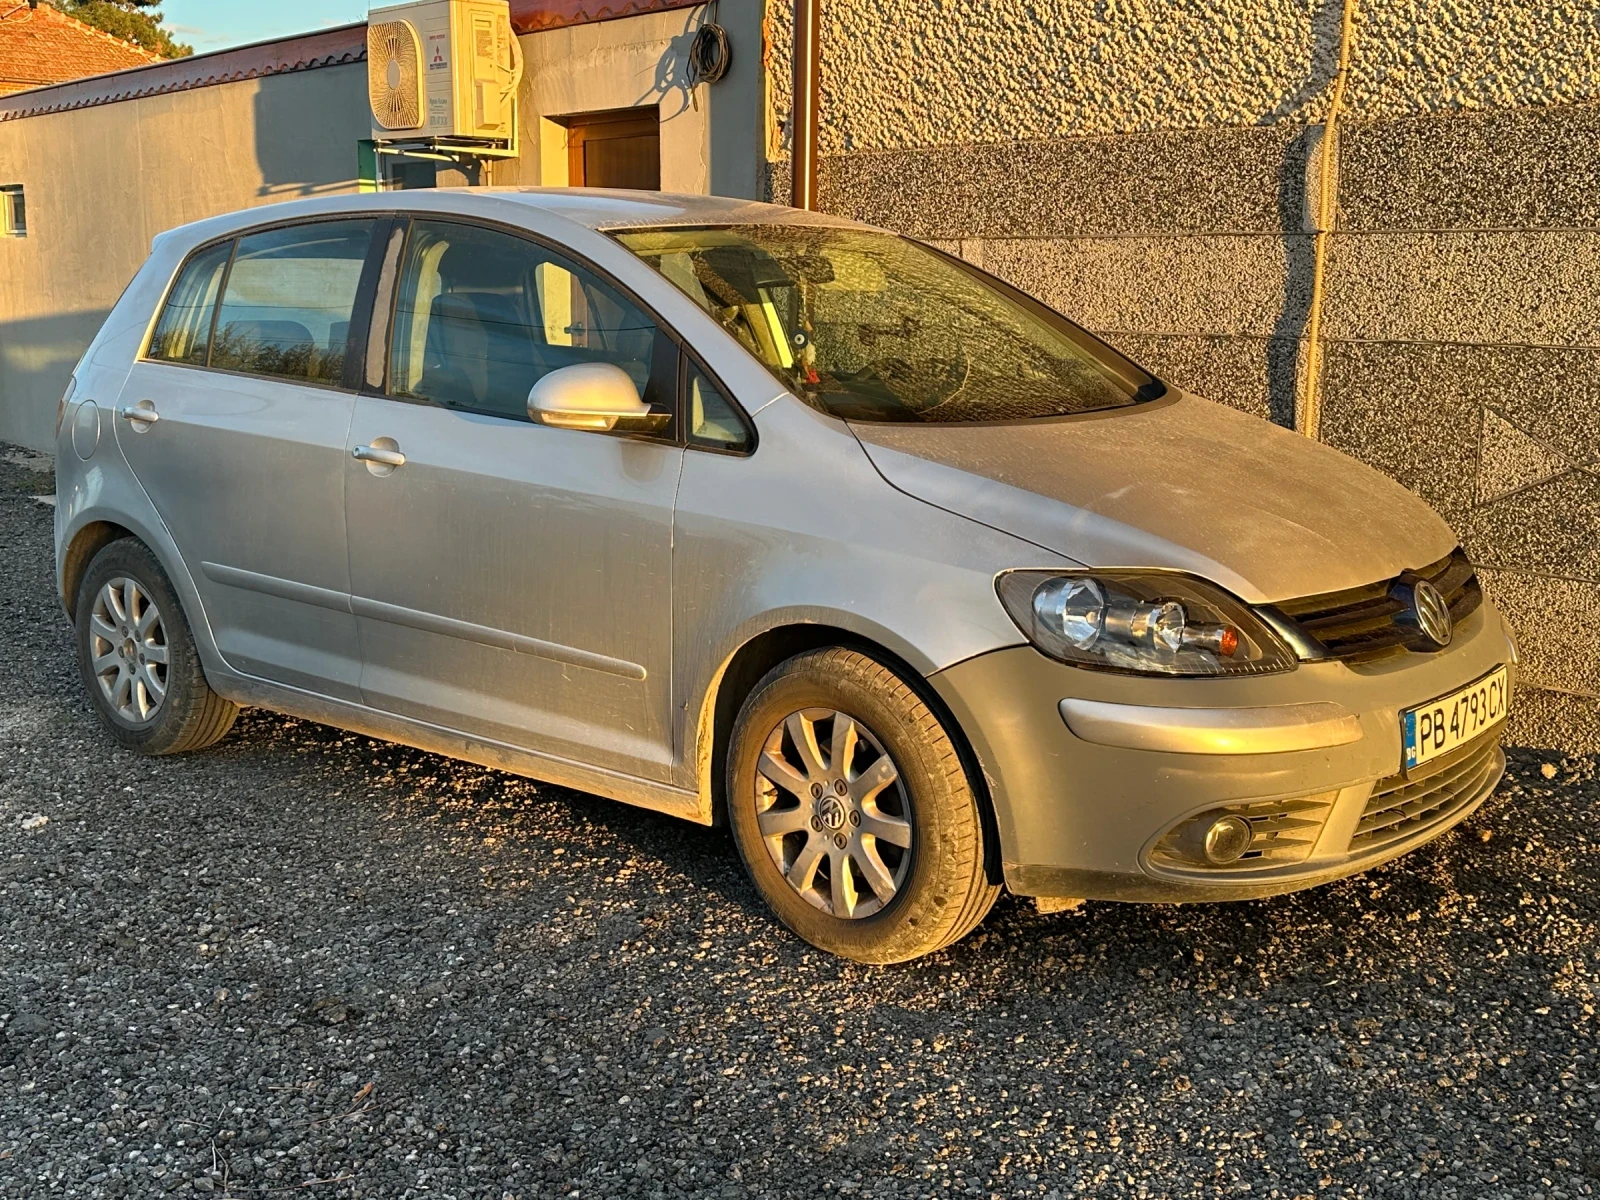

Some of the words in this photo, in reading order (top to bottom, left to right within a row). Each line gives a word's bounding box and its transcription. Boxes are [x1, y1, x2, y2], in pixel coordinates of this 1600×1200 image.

[1420, 707, 1446, 756] PB
[1450, 687, 1487, 740] 4793
[1488, 674, 1505, 719] CX
